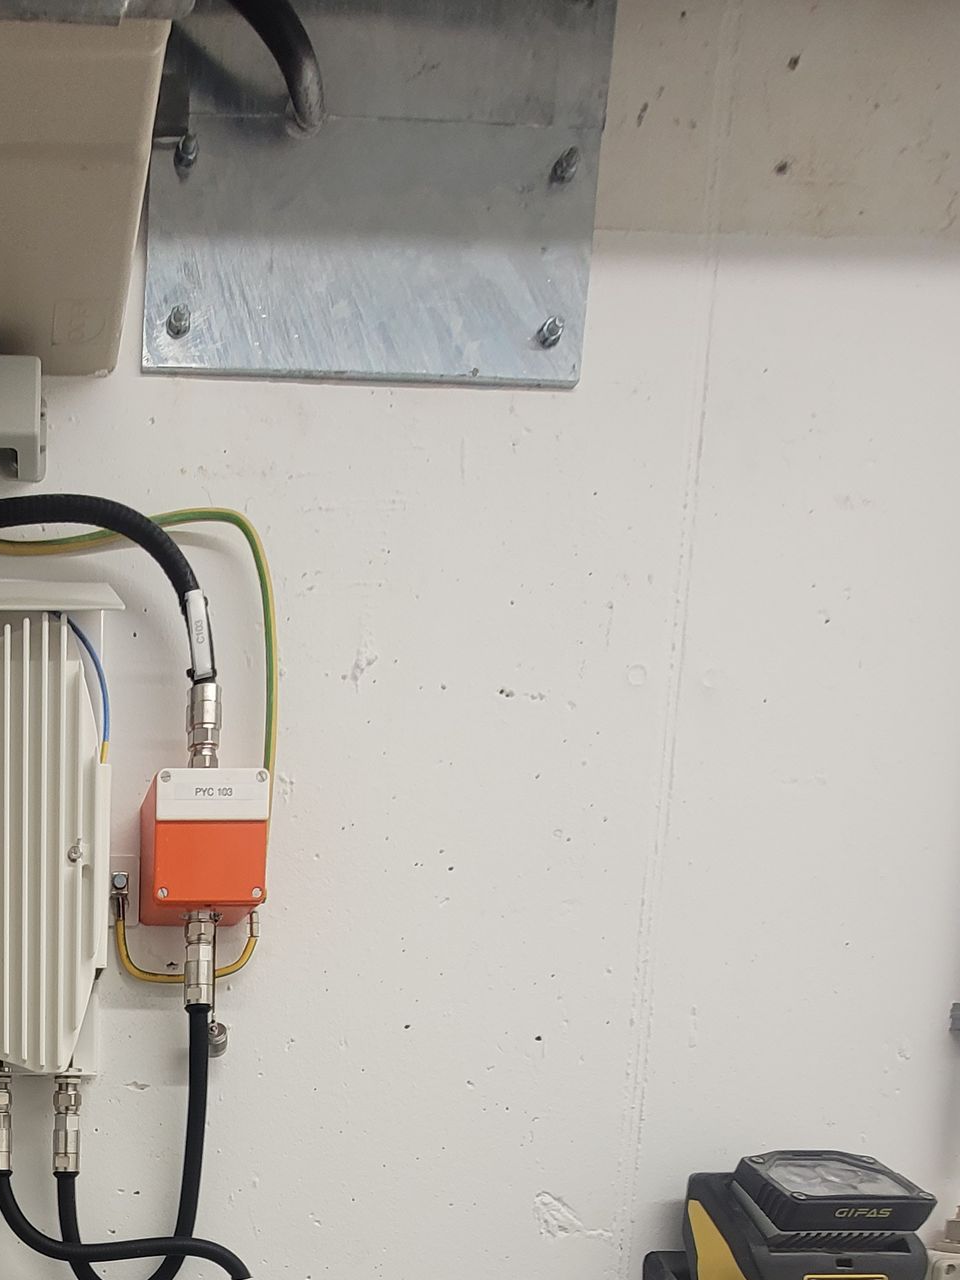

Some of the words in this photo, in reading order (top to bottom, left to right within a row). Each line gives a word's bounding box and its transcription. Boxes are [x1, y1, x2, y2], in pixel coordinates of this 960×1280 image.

[194, 619, 205, 644] C103
[194, 787, 214, 797] PYC
[217, 787, 233, 797] 103
[834, 1208, 893, 1218] GIFAS
